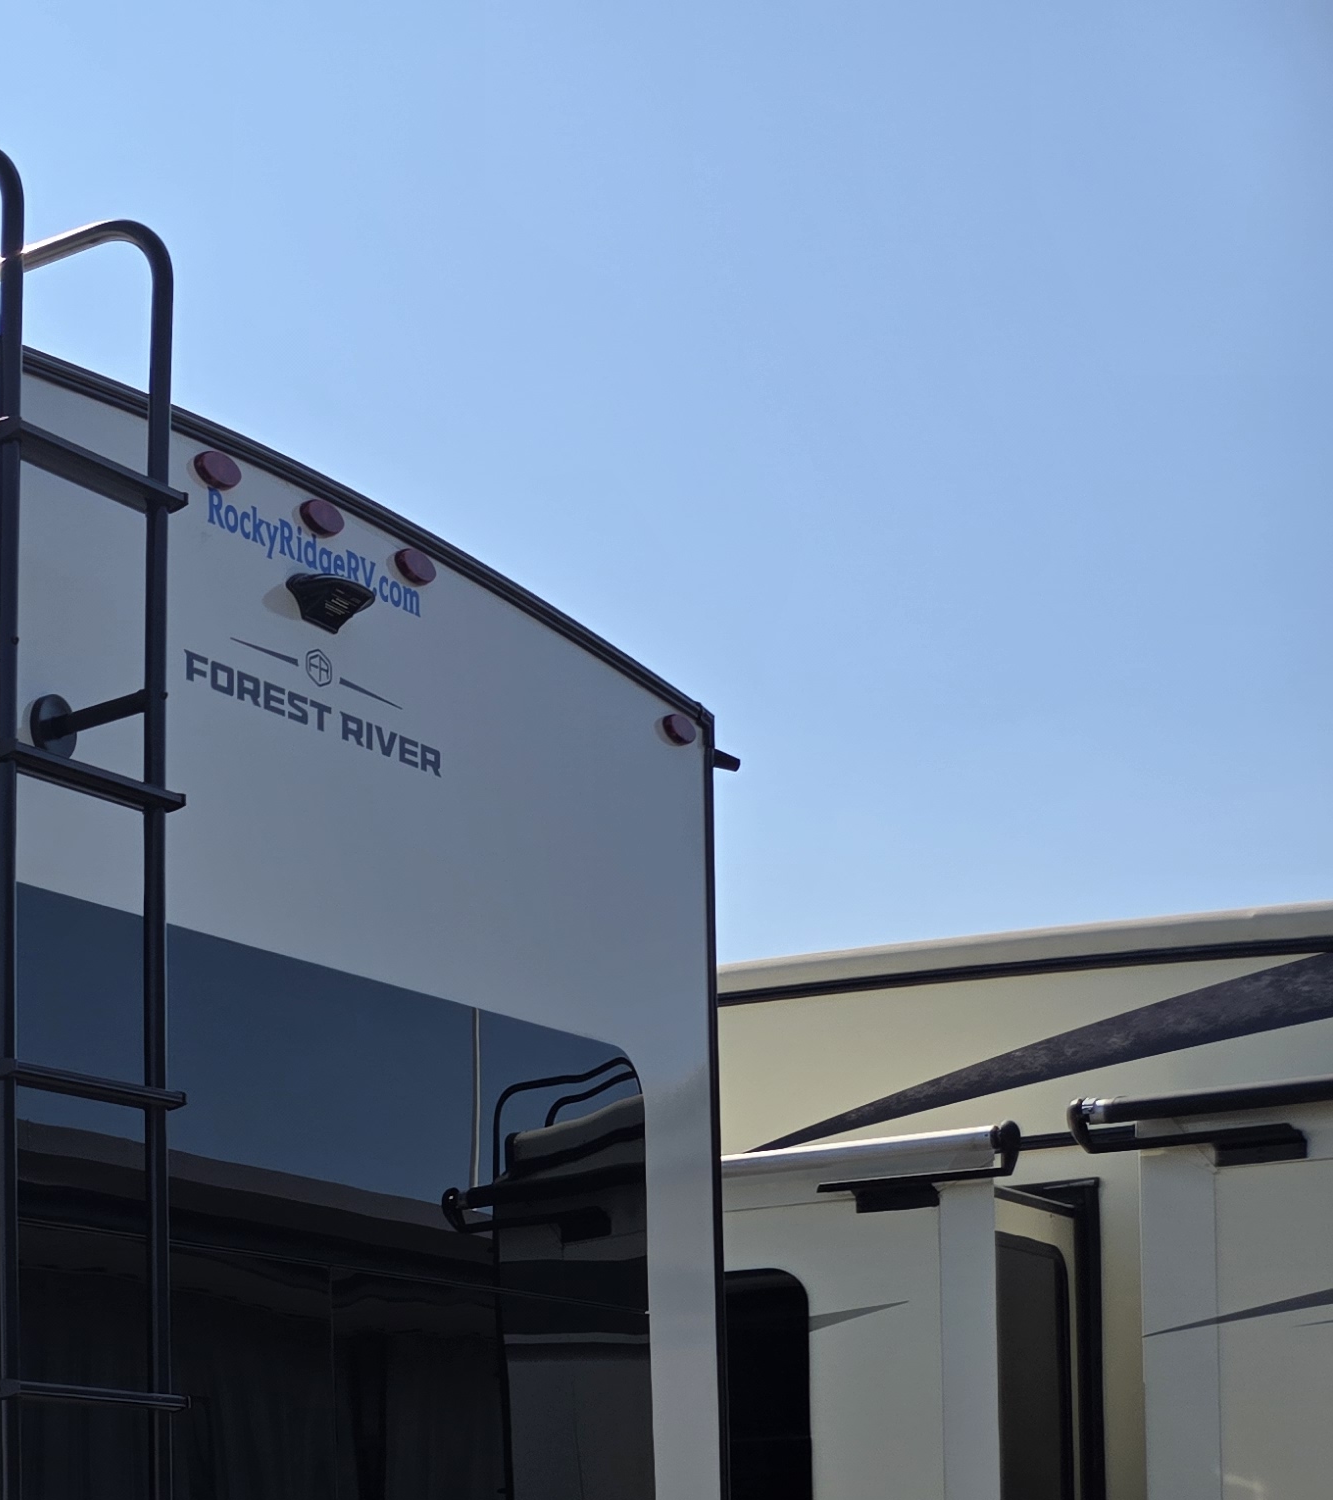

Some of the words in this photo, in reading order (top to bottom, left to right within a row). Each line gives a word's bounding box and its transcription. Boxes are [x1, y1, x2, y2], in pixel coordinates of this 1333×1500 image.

[208, 487, 421, 617] RockyRidgeRV.com
[184, 649, 332, 732] FOREST
[340, 711, 442, 778] RIVER
